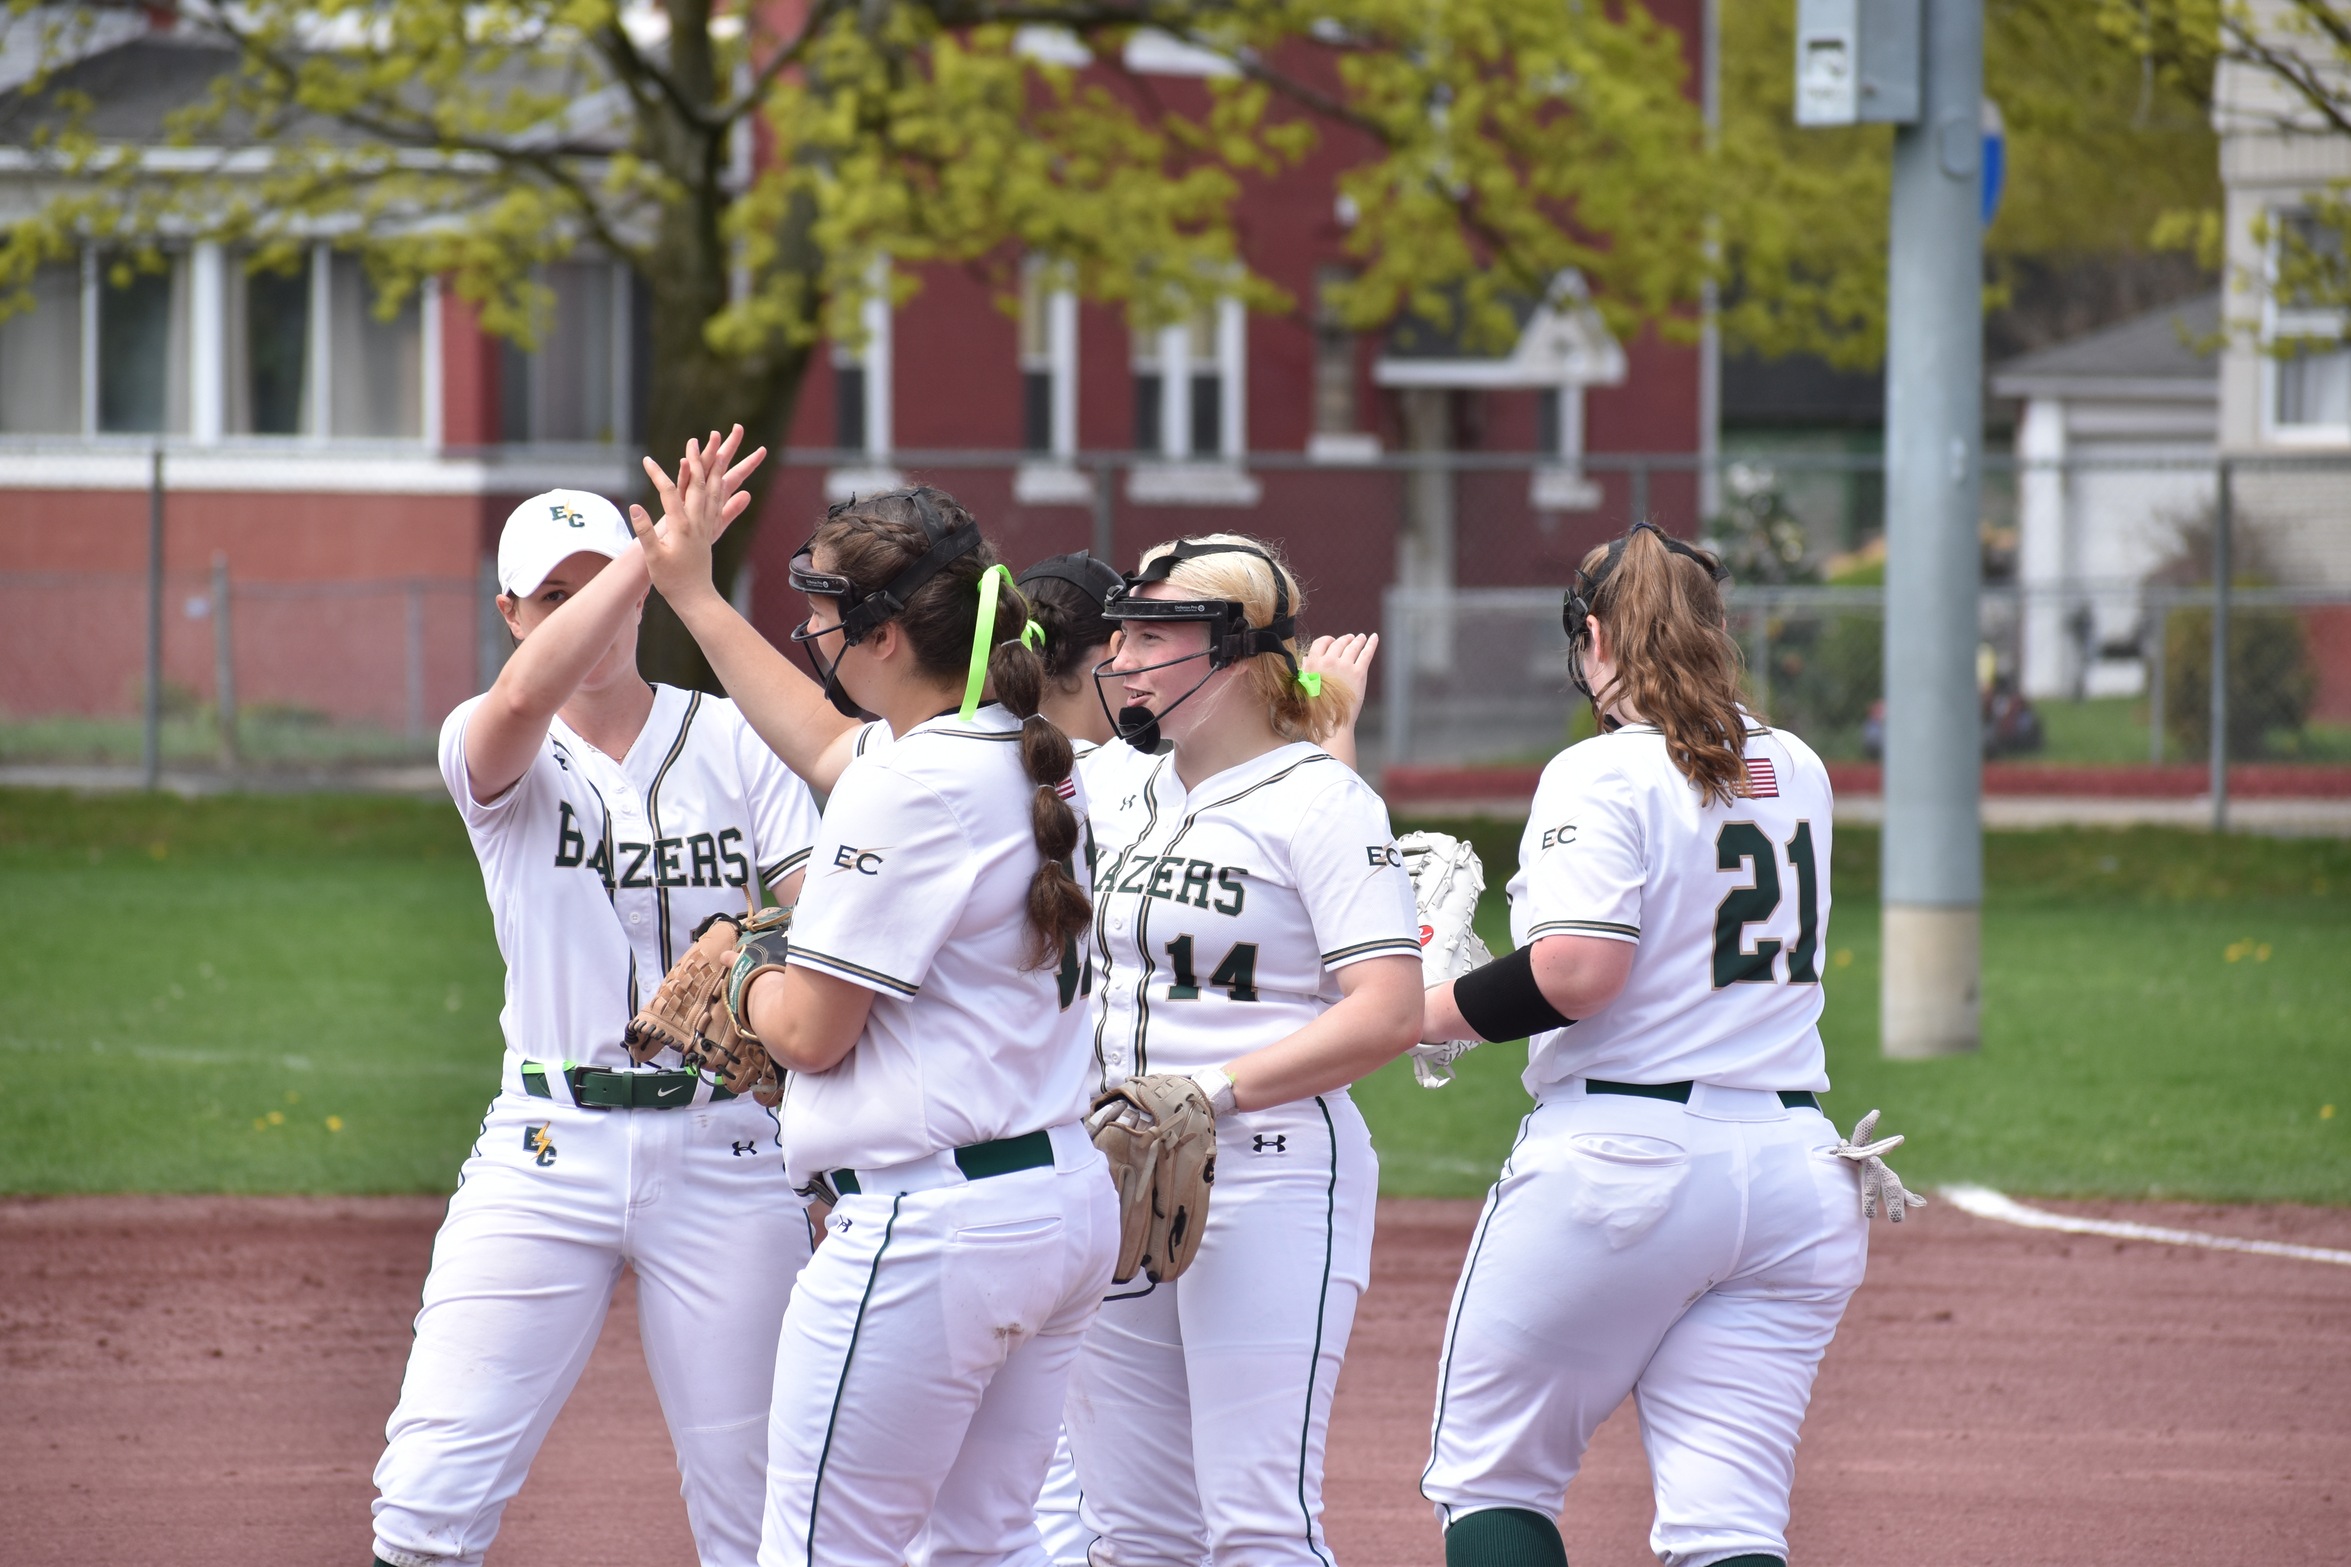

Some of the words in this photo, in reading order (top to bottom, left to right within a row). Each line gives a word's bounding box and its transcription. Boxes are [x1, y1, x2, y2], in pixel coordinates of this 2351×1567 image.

[549, 505, 585, 527] EC
[553, 799, 749, 889] BAZERS
[1541, 825, 1577, 850] EC
[833, 844, 883, 875] EC
[1366, 846, 1401, 868] EC
[1711, 819, 1820, 991] 21
[1165, 932, 1260, 1003] 14
[523, 1126, 557, 1166] EC
